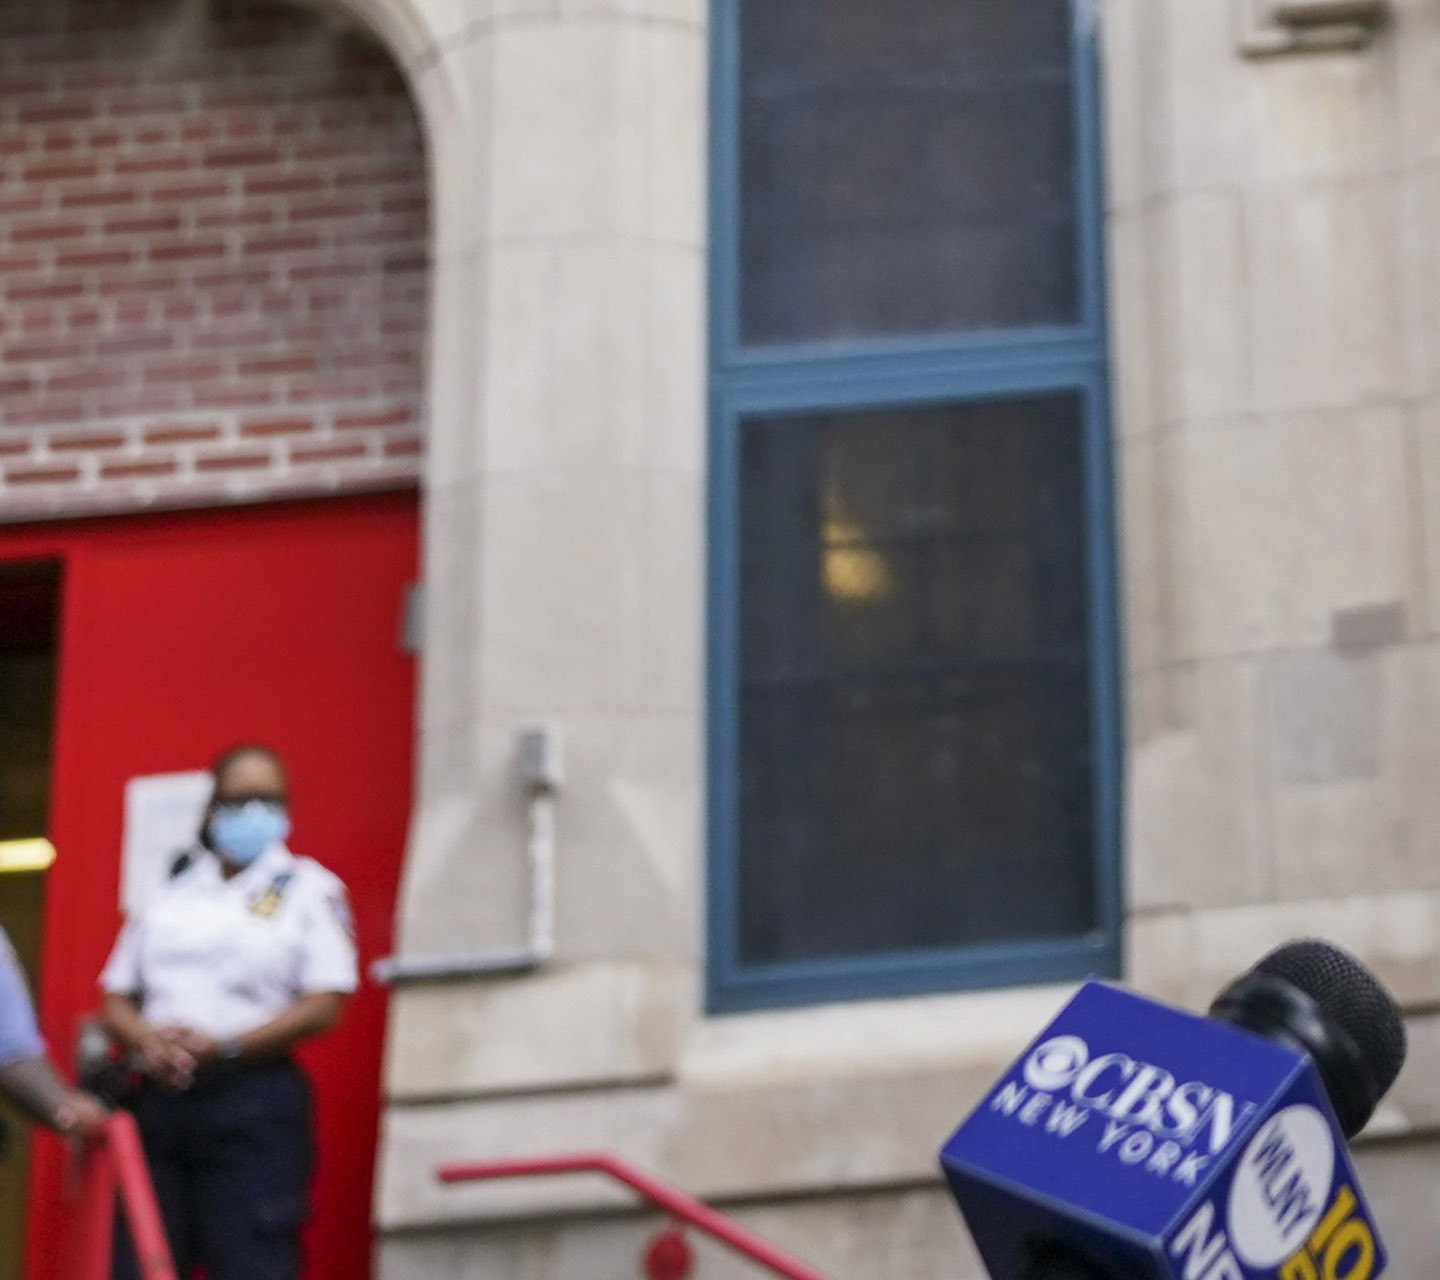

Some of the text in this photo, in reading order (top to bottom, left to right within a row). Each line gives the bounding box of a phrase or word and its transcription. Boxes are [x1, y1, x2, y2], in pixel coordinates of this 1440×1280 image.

[990, 1080, 1209, 1187] NEW YORK
[1071, 1052, 1257, 1155] CBSN
